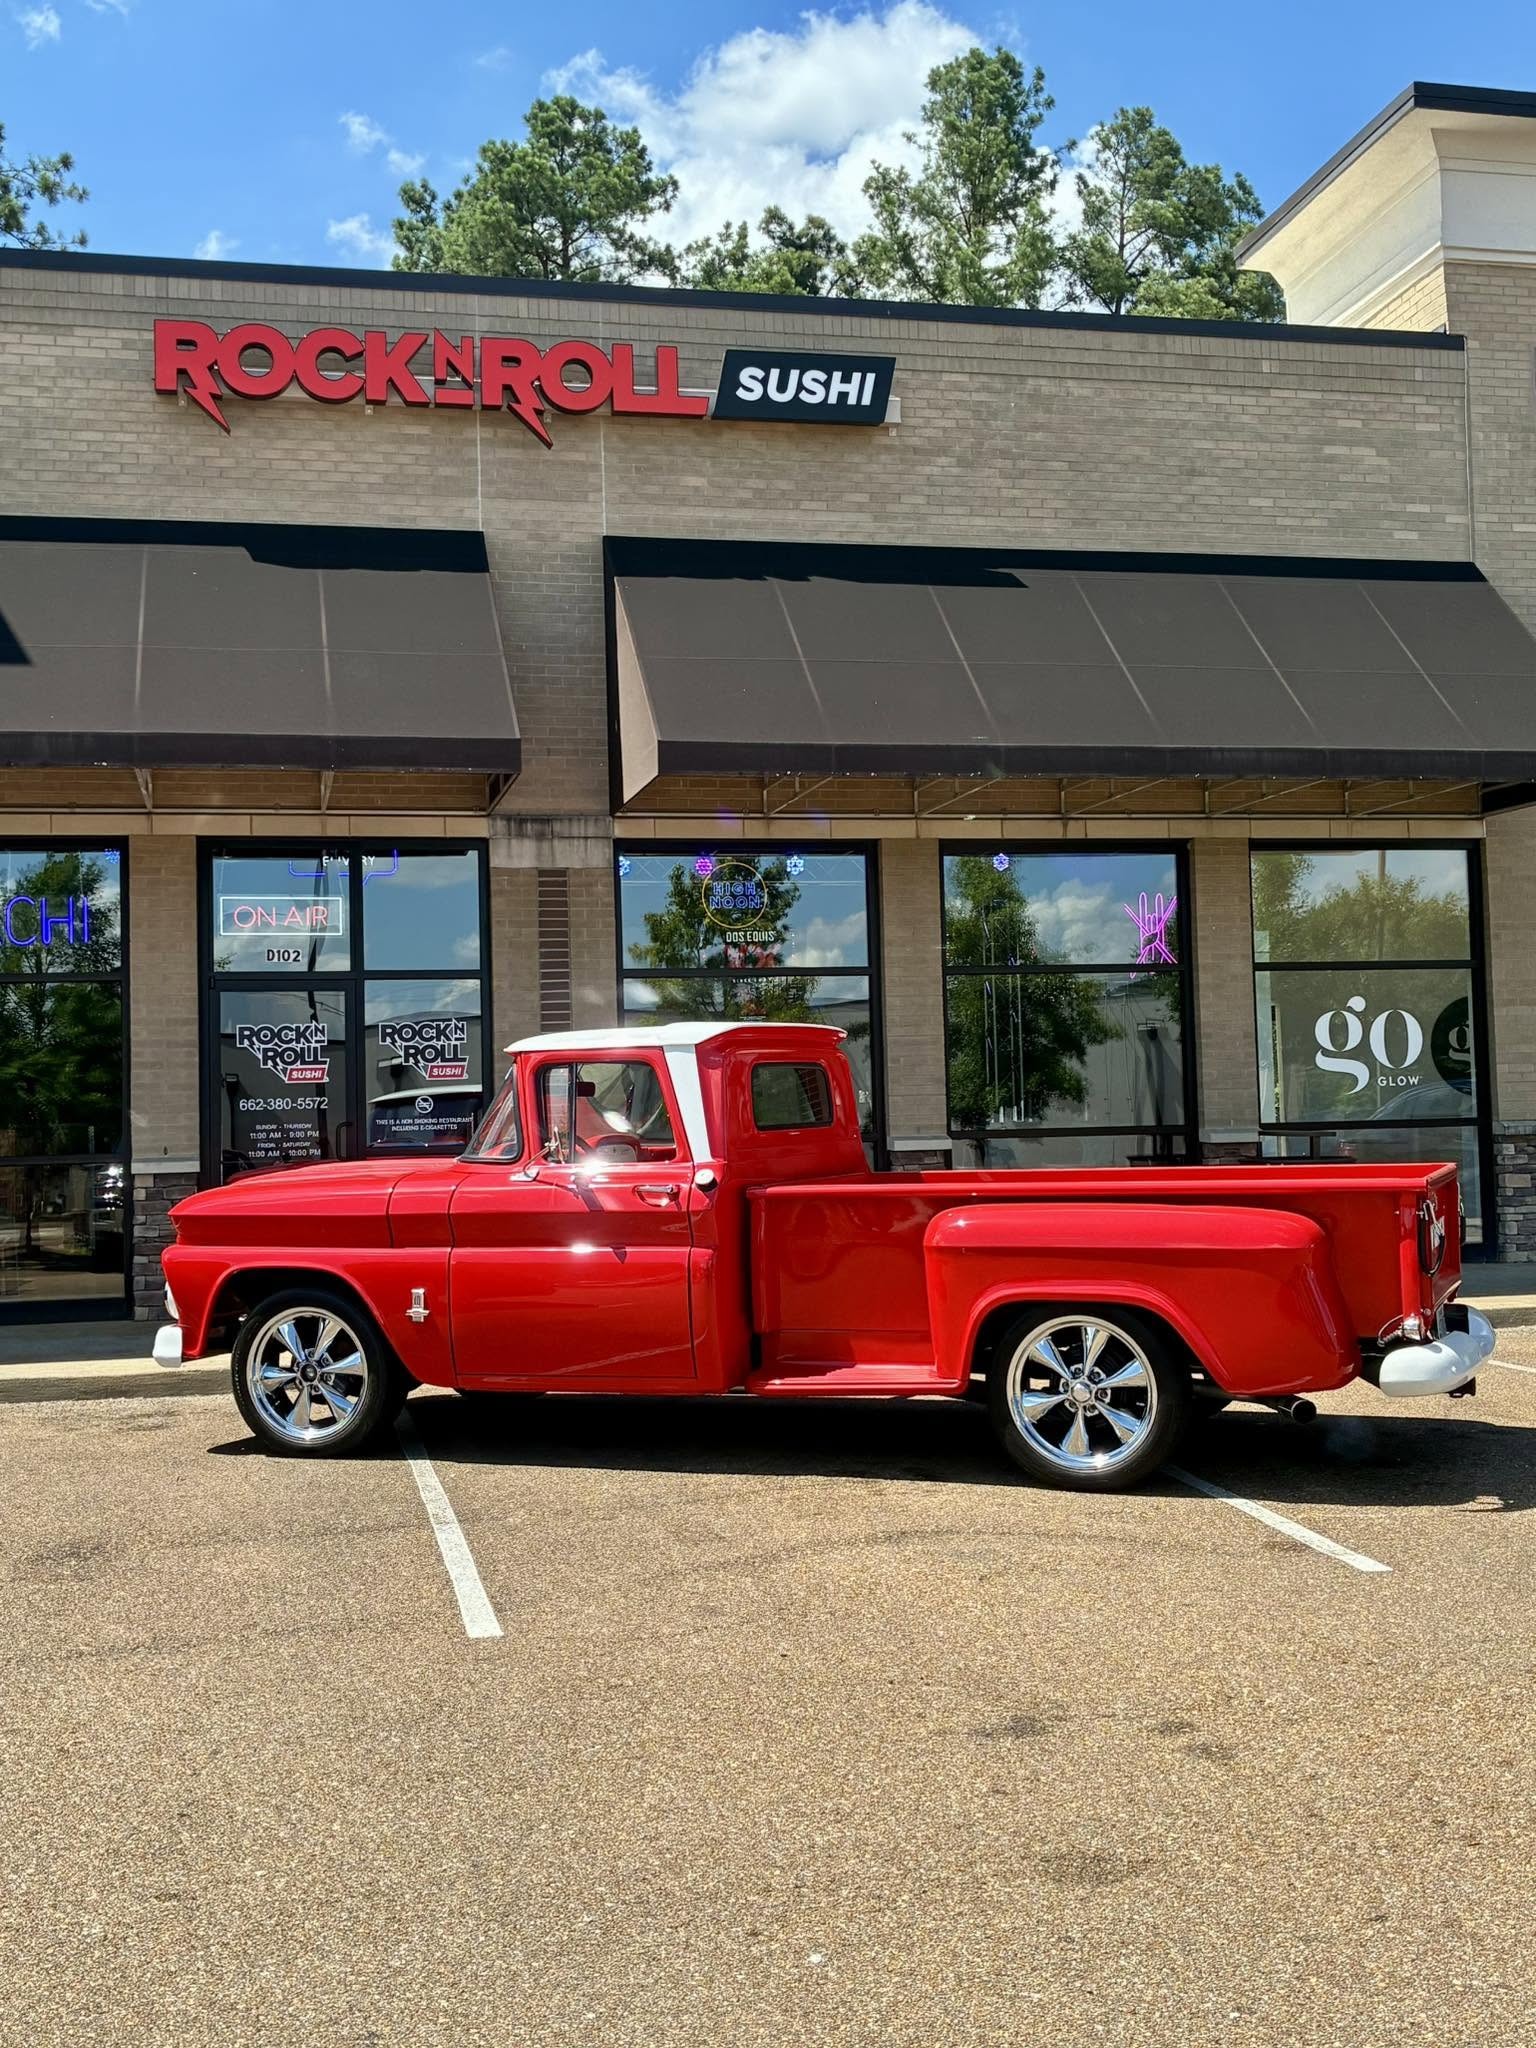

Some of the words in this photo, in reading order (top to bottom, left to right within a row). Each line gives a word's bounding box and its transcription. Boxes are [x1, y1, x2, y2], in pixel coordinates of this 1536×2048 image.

[154, 319, 431, 436] ROCK
[434, 328, 474, 406] N
[480, 337, 710, 449] ROLL
[735, 366, 877, 406] SUSHI
[713, 882, 756, 895] HIGH
[709, 896, 760, 909] NOON
[0, 896, 89, 946] CHI
[234, 906, 276, 928] ON
[284, 906, 328, 927] AIR
[726, 932, 745, 943] DOS
[747, 931, 775, 942] EQUIS
[266, 949, 301, 963] D102
[236, 1023, 313, 1058] ROCK
[379, 1022, 453, 1055] ROCK
[1314, 996, 1423, 1095] go
[261, 1045, 329, 1082] ROLL
[402, 1042, 469, 1078] ROLL
[291, 1070, 322, 1079] SUSHI
[432, 1067, 461, 1076] SUSHI
[1377, 1076, 1420, 1087] GLOW
[239, 1097, 328, 1111] 662-380-5572
[307, 1130, 319, 1138] PM
[248, 1150, 265, 1158] 11:00
[309, 1148, 321, 1156] PM
